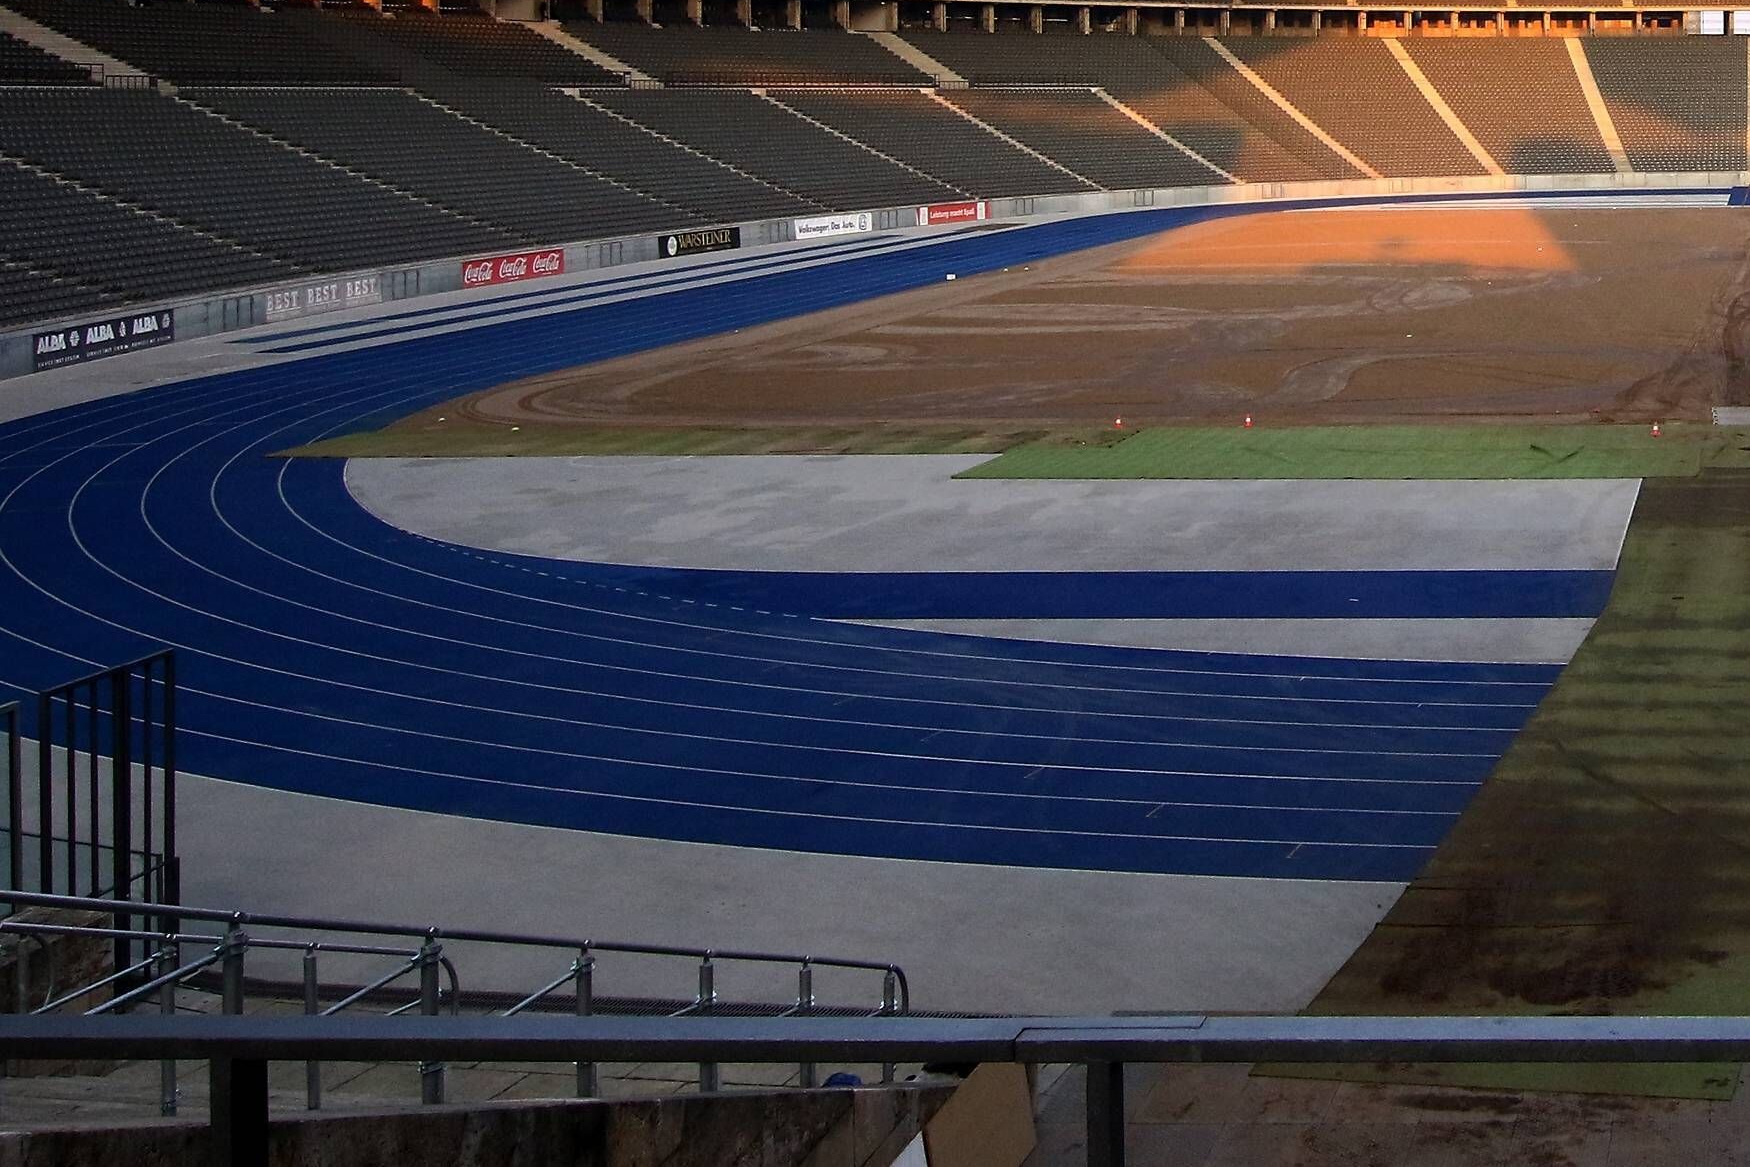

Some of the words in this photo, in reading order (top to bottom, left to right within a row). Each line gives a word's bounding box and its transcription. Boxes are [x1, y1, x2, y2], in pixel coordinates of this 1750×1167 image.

[679, 230, 731, 249] WARSTEINER
[267, 291, 299, 311] BEST
[307, 284, 338, 304] BEST
[346, 278, 376, 297] BEST
[37, 333, 67, 354] ALBA
[86, 324, 115, 345] ALBA
[132, 315, 159, 335] ALBA
